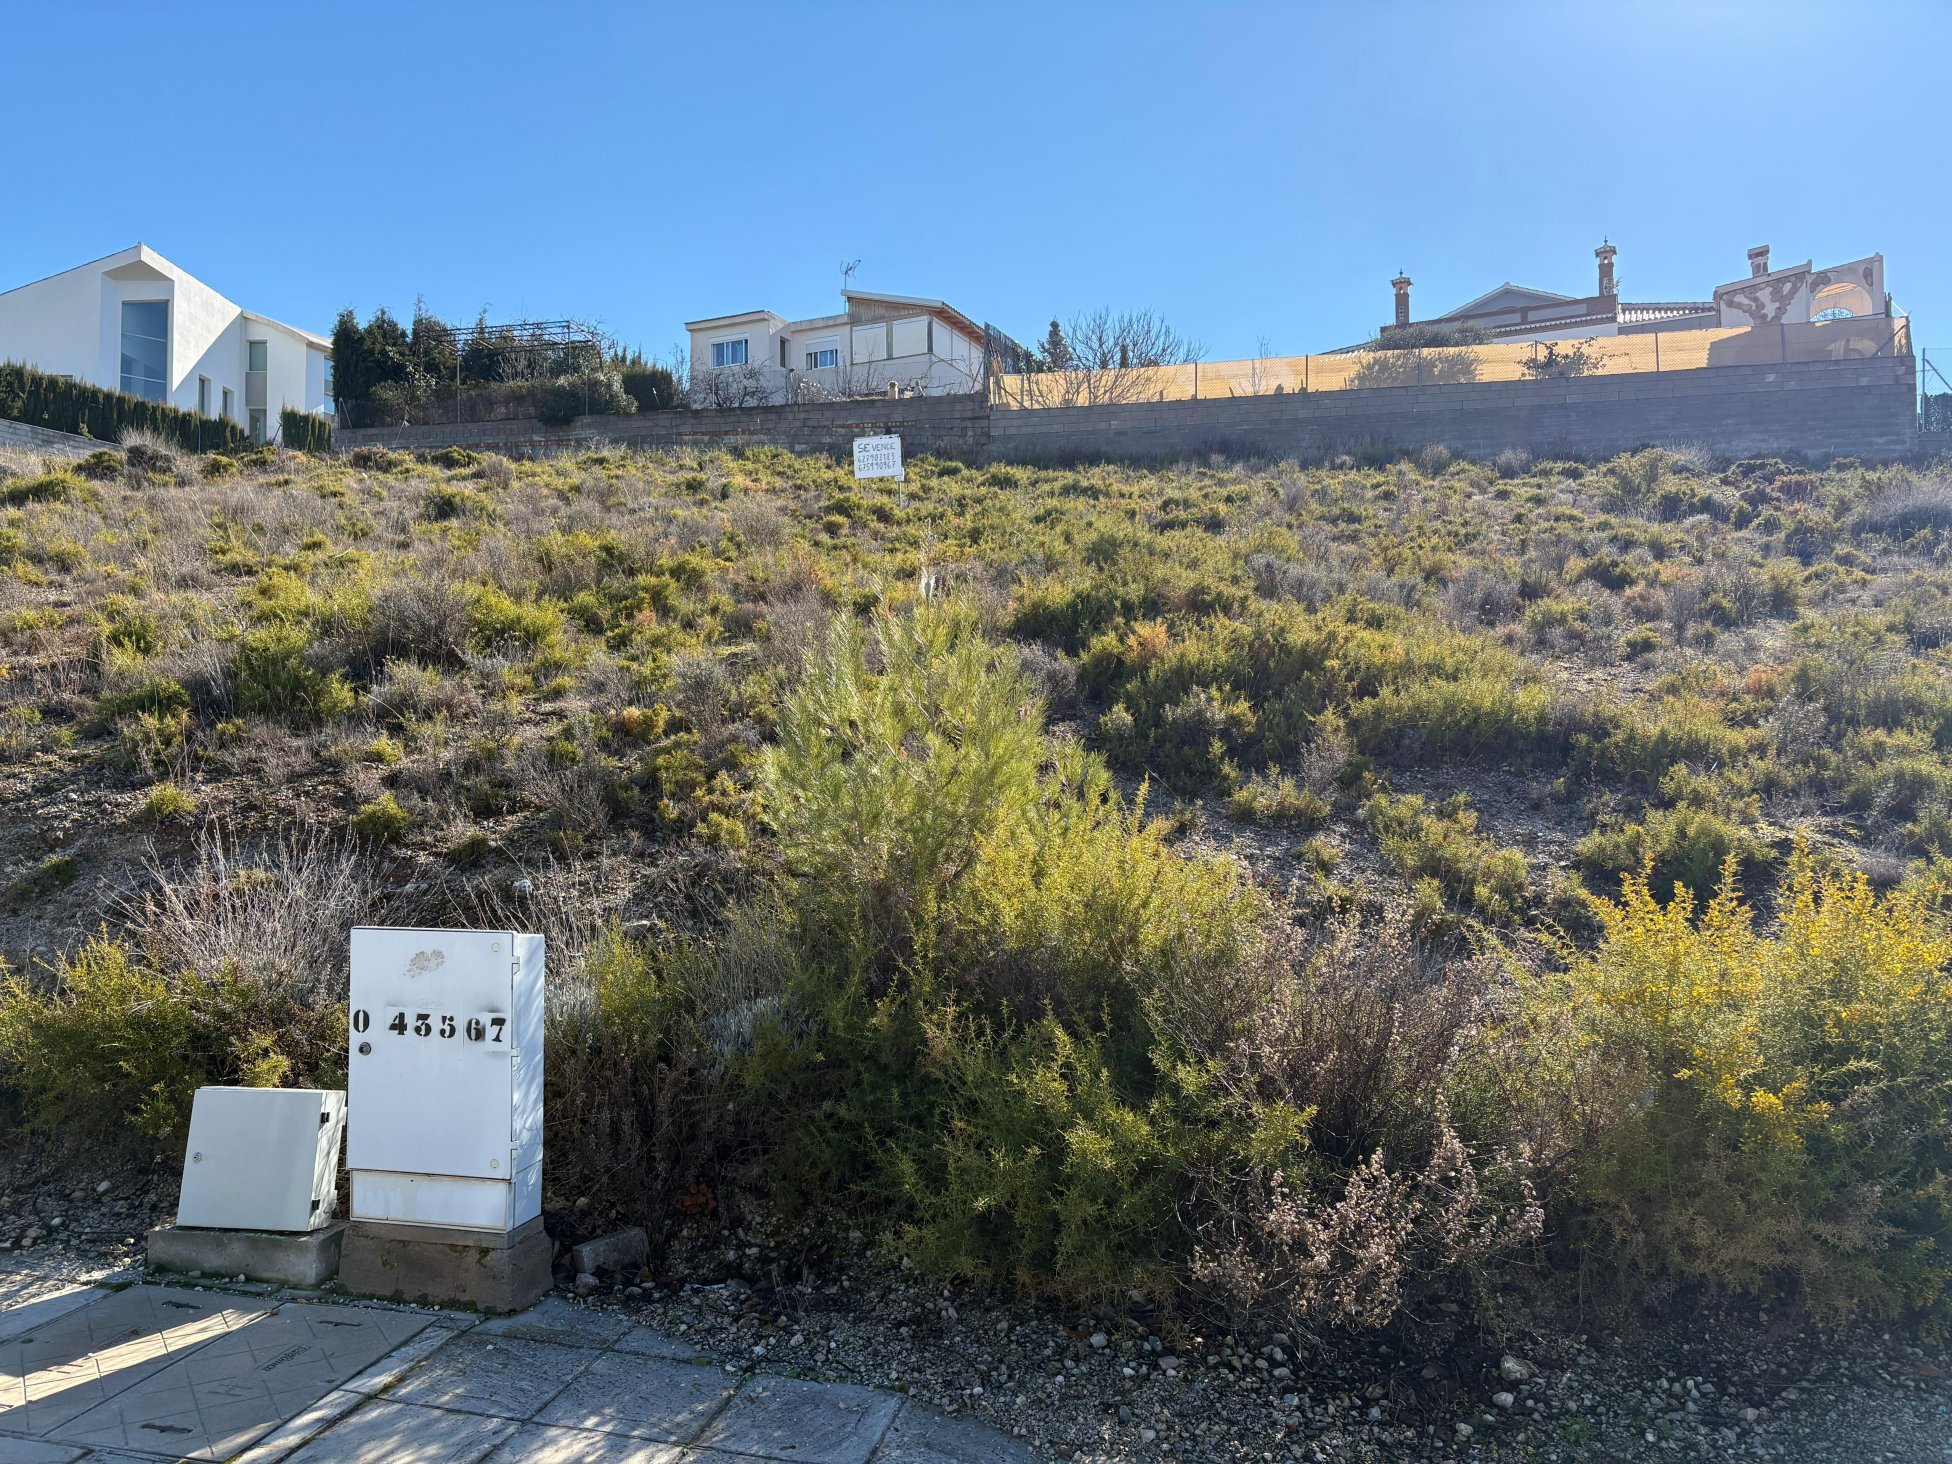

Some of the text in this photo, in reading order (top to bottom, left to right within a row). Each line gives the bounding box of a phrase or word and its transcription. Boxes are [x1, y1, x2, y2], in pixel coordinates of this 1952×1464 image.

[857, 442, 896, 453] SE VENDE
[353, 1009, 507, 1042] 0 43567
